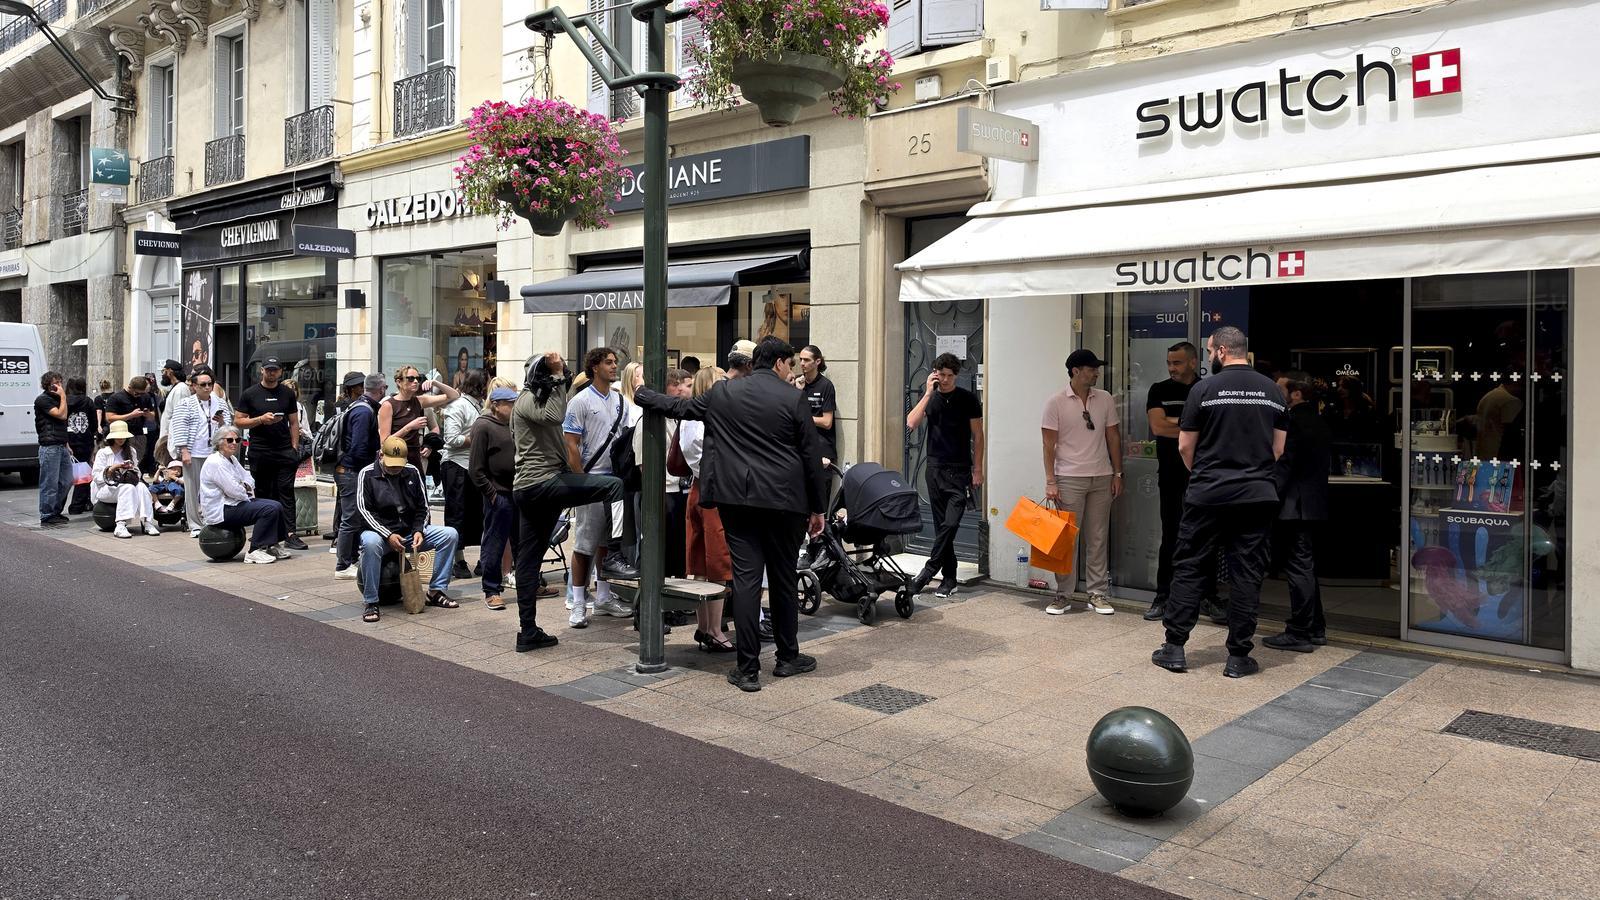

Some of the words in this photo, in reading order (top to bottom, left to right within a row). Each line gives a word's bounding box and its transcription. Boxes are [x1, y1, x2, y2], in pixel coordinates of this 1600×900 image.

[908, 133, 932, 156] 25
[280, 186, 326, 209] CHEVIGNON
[366, 188, 472, 228] CALZEDON
[220, 218, 279, 248] CHEVIGNON
[138, 238, 180, 250] CHEVIGNON
[298, 242, 351, 255] CALZEDONIA
[583, 291, 645, 311] DORIAN
[1447, 516, 1510, 526] SCUBAQUA
